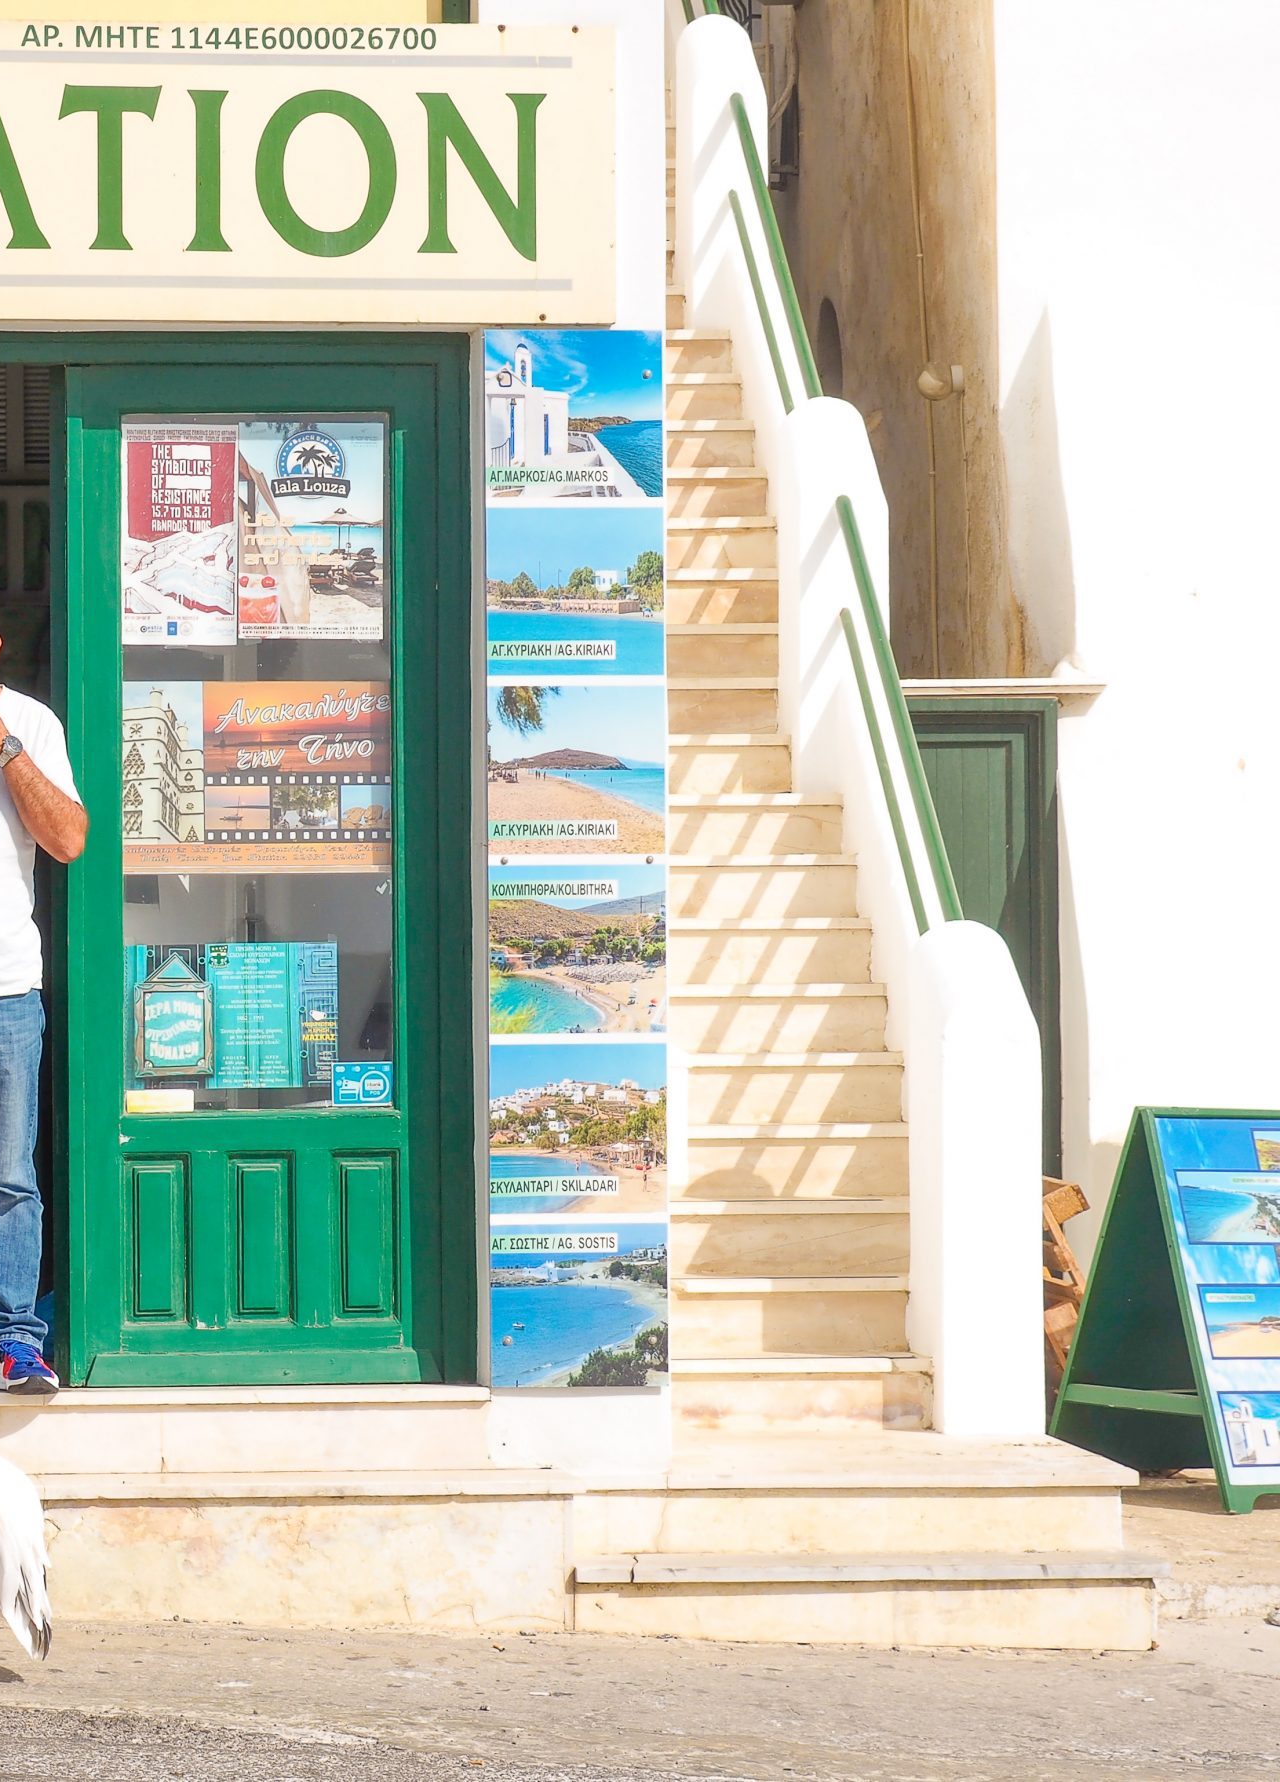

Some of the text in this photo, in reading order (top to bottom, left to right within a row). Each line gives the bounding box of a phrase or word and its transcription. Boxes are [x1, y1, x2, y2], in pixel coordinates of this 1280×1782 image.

[21, 25, 63, 48] ΑΡ.
[75, 25, 160, 49] ΜΗΤΕ
[151, 445, 171, 459] THE
[151, 459, 211, 475] SYMBOLICS
[151, 475, 165, 489] OF
[273, 479, 347, 494] lala Louza
[151, 489, 211, 504] RESISTANCE
[151, 506, 211, 518] 15.7 TO 15.9.21
[243, 549, 280, 566] and
[491, 644, 552, 657] ΑΓ.ΚΥΡΙΑΚΗ
[236, 732, 375, 770] την Τήνο
[493, 824, 554, 836] ΑΓ.ΚΥΡΙΑΚΗ
[491, 883, 613, 896] ΚΟΛΥΜΠΗΘΡΑ/KOLIBITHRA
[490, 1181, 553, 1194] ΣΚΥΛΑΝΤΑΡΙ
[561, 1179, 617, 1192] SKILADARI
[492, 1238, 507, 1250] ΑΓ.
[509, 1237, 549, 1250] ΣΩΣΤΗΣ
[557, 1237, 576, 1249] AG.
[578, 1236, 616, 1249] SOSTIS
